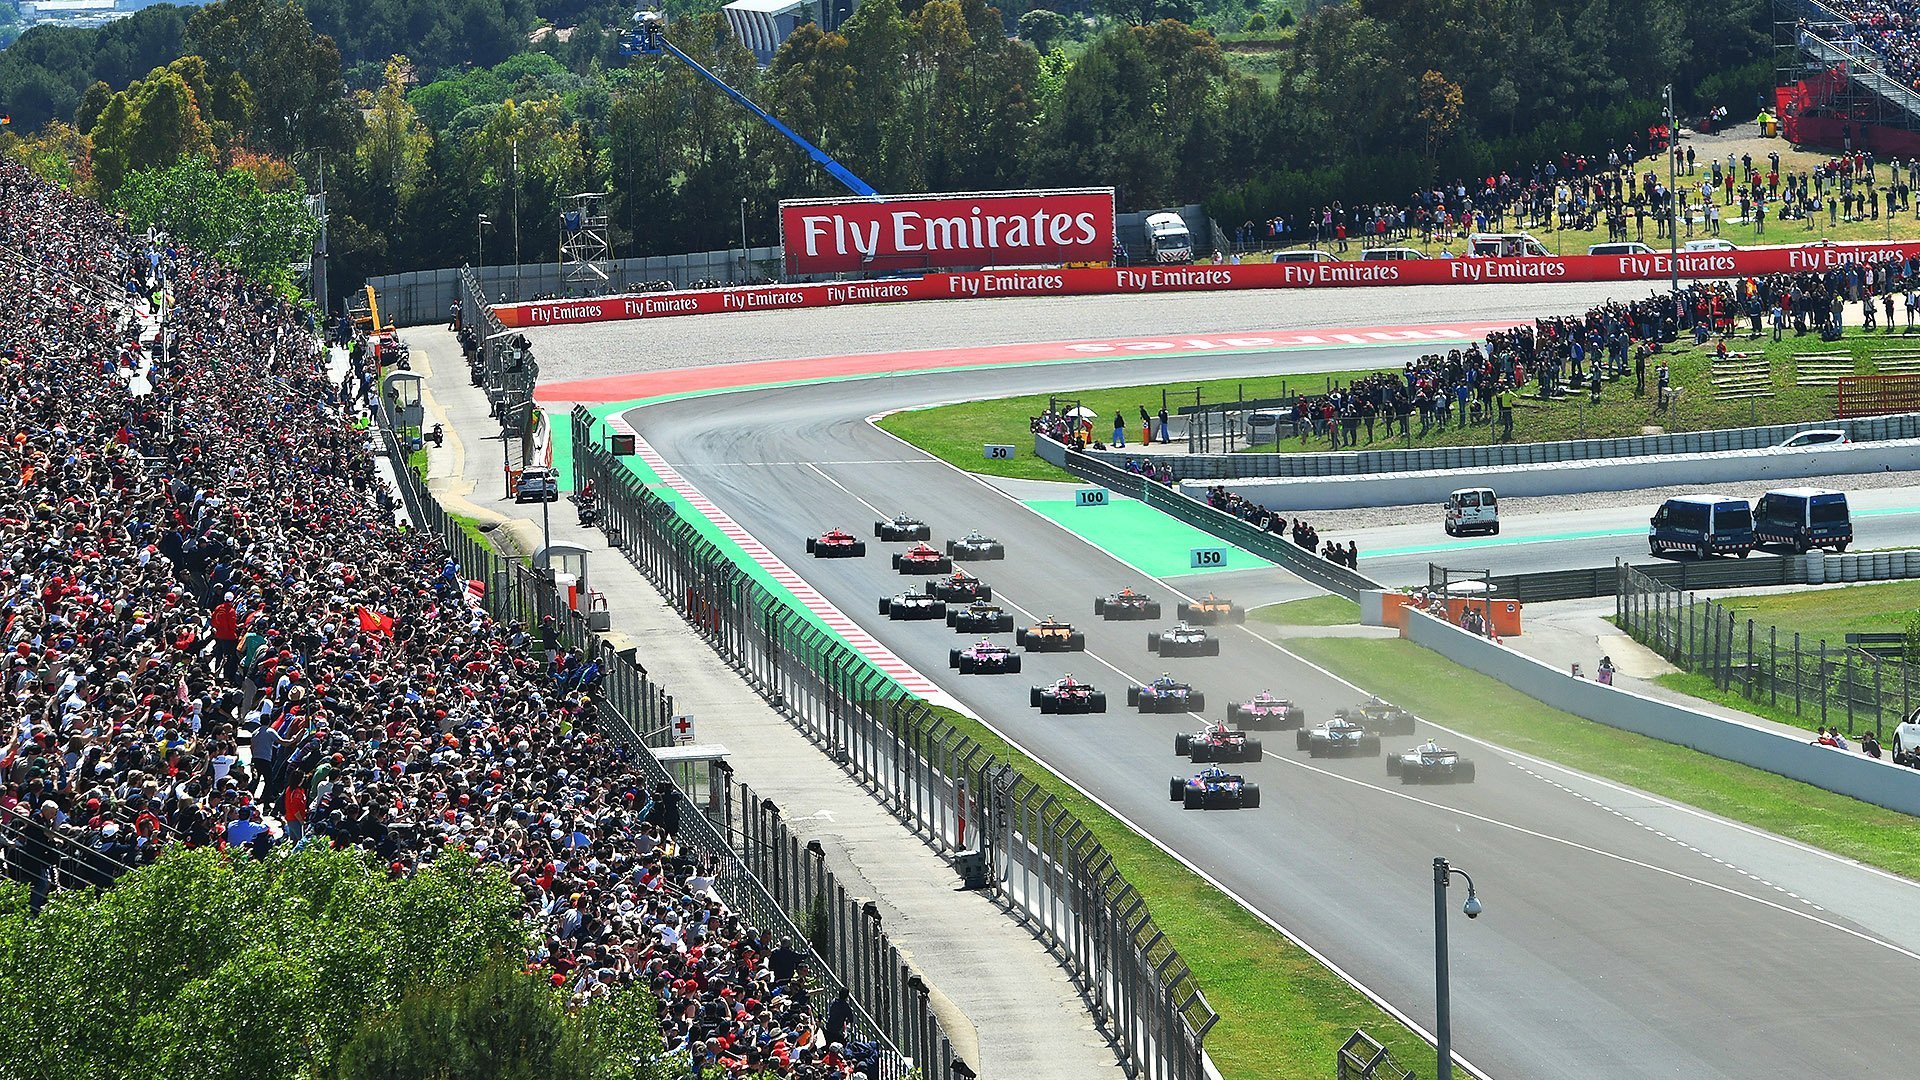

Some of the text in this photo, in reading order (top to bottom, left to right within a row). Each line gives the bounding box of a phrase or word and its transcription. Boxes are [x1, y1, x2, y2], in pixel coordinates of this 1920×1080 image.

[802, 206, 1097, 262] Fly Emirates
[1620, 257, 1651, 276] Fly
[1790, 251, 1820, 270] Fly
[1117, 270, 1232, 289] Fly Emirates
[1285, 264, 1399, 285] Fly Emirates
[1451, 260, 1565, 281] Fly Emirates
[828, 284, 909, 303] Fly Emirates
[949, 274, 1063, 295] Fly Emirates
[625, 297, 698, 316] Fly Emirates
[724, 291, 804, 309] Fly Emirates
[531, 305, 602, 322] Fly Emirates
[991, 447, 1007, 458] 50
[1080, 491, 1103, 503] 100
[1196, 551, 1221, 564] 150
